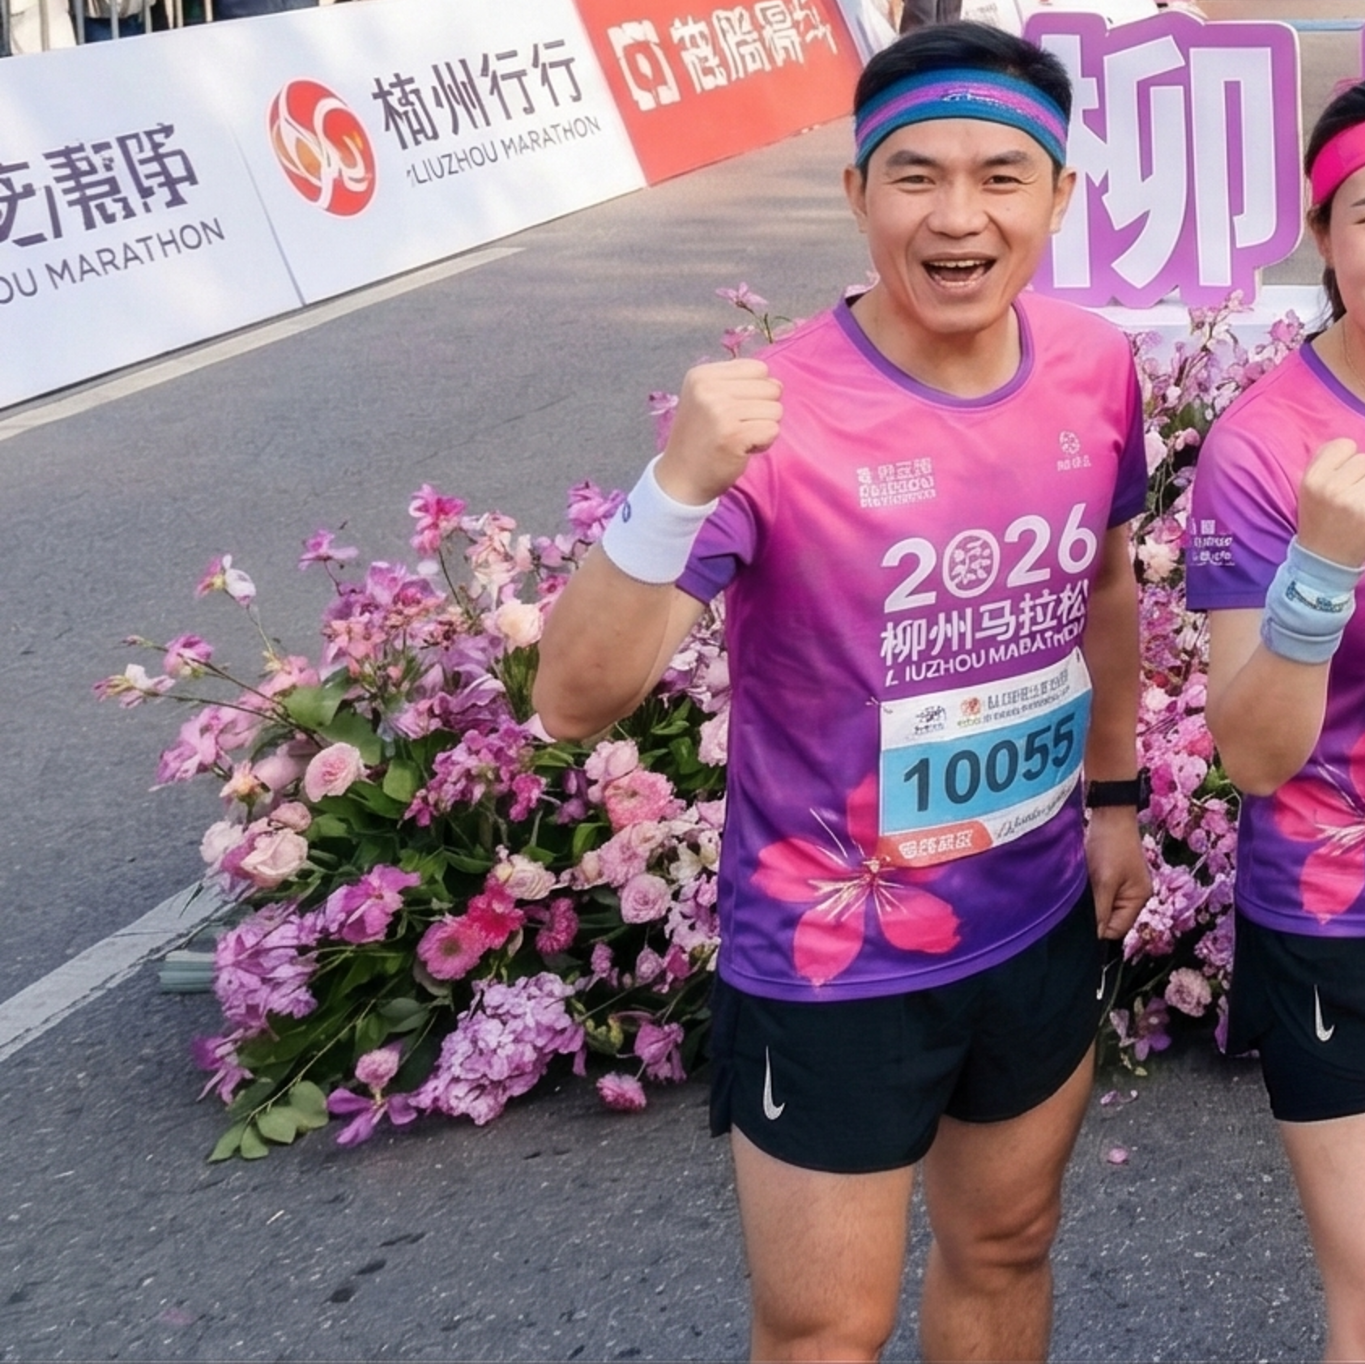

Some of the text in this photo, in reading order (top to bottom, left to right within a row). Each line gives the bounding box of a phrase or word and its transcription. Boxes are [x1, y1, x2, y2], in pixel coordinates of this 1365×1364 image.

[501, 115, 602, 159] MARATHON
[45, 217, 225, 290] MARATHON
[880, 503, 1097, 613] 2026
[880, 579, 1089, 667] 柳州马拉松
[903, 711, 1076, 813] 10055
